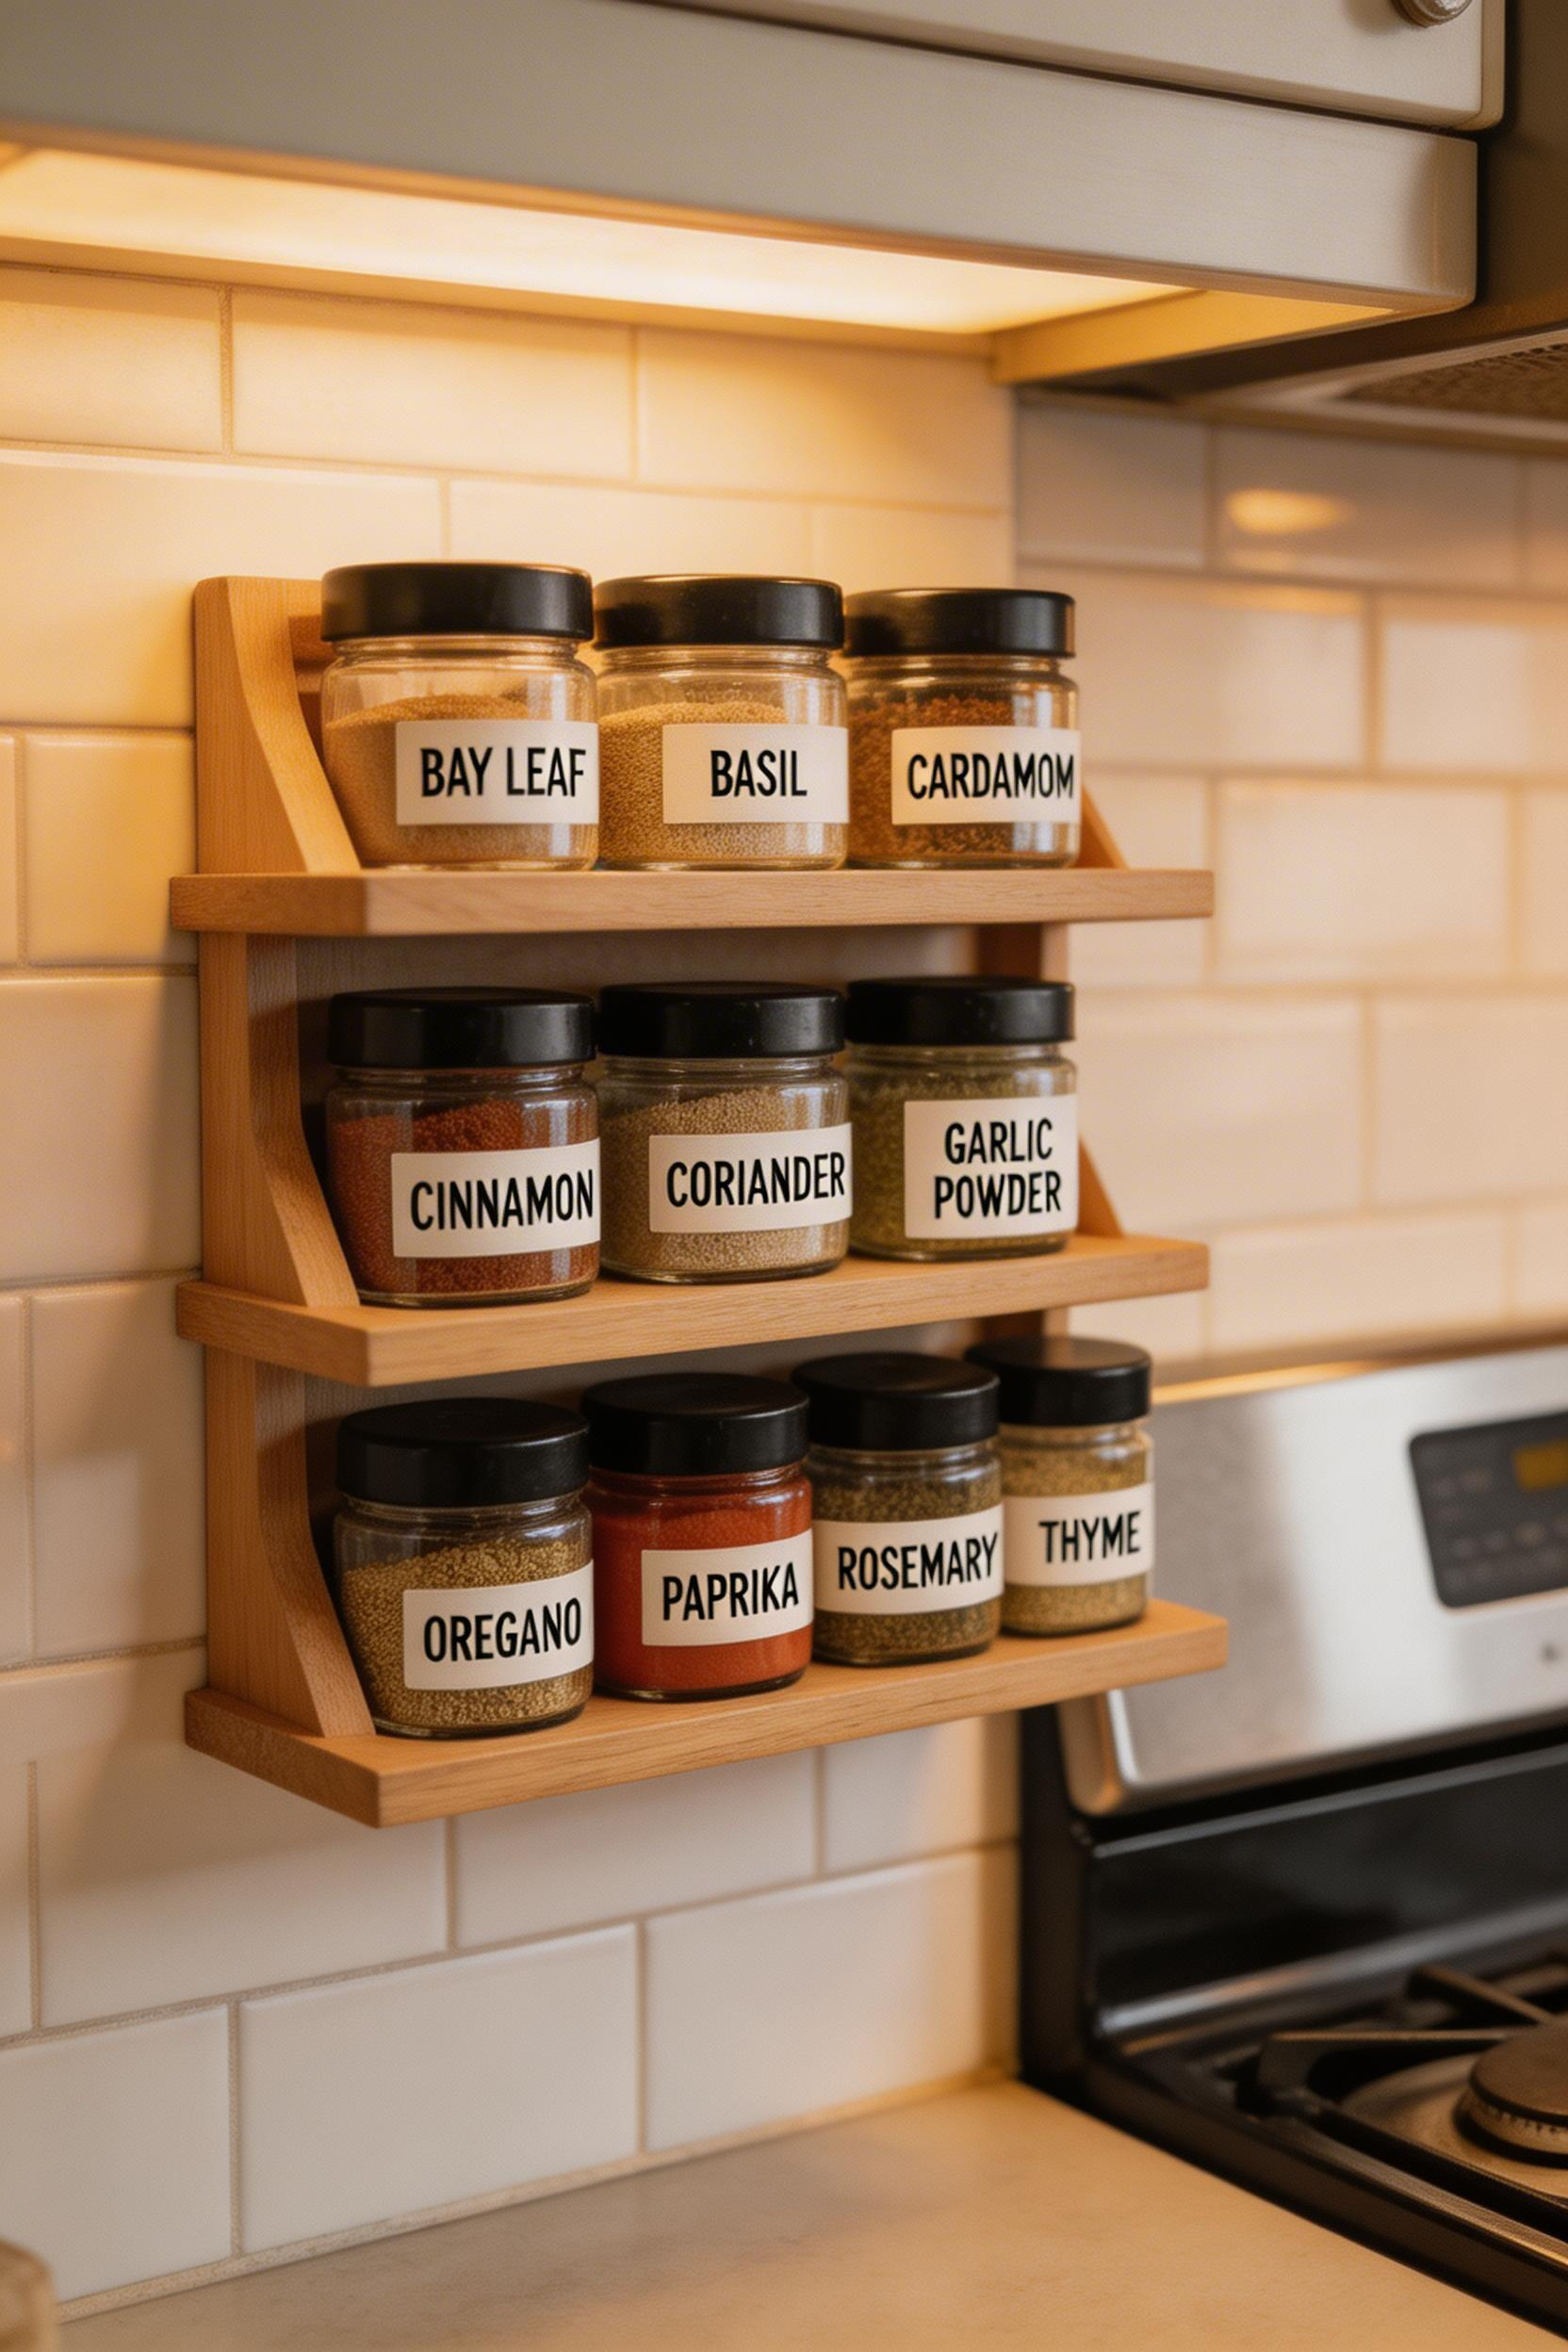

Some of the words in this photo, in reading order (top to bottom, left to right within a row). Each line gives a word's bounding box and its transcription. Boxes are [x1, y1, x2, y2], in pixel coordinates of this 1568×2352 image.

[420, 747, 491, 798] BAY
[506, 746, 586, 797] LEAF
[710, 749, 808, 798] BASIL
[906, 753, 1074, 801] CARDAMOM
[943, 1119, 1054, 1165] GARLIC
[410, 1168, 595, 1232] CINNAMON
[666, 1152, 845, 1208] CORIANDER
[934, 1170, 1062, 1219] POWDER
[838, 1532, 999, 1591] ROSEMARY
[1039, 1510, 1141, 1564] THYME
[662, 1561, 800, 1622] PAPRIKA
[423, 1596, 582, 1663] OREGANO
